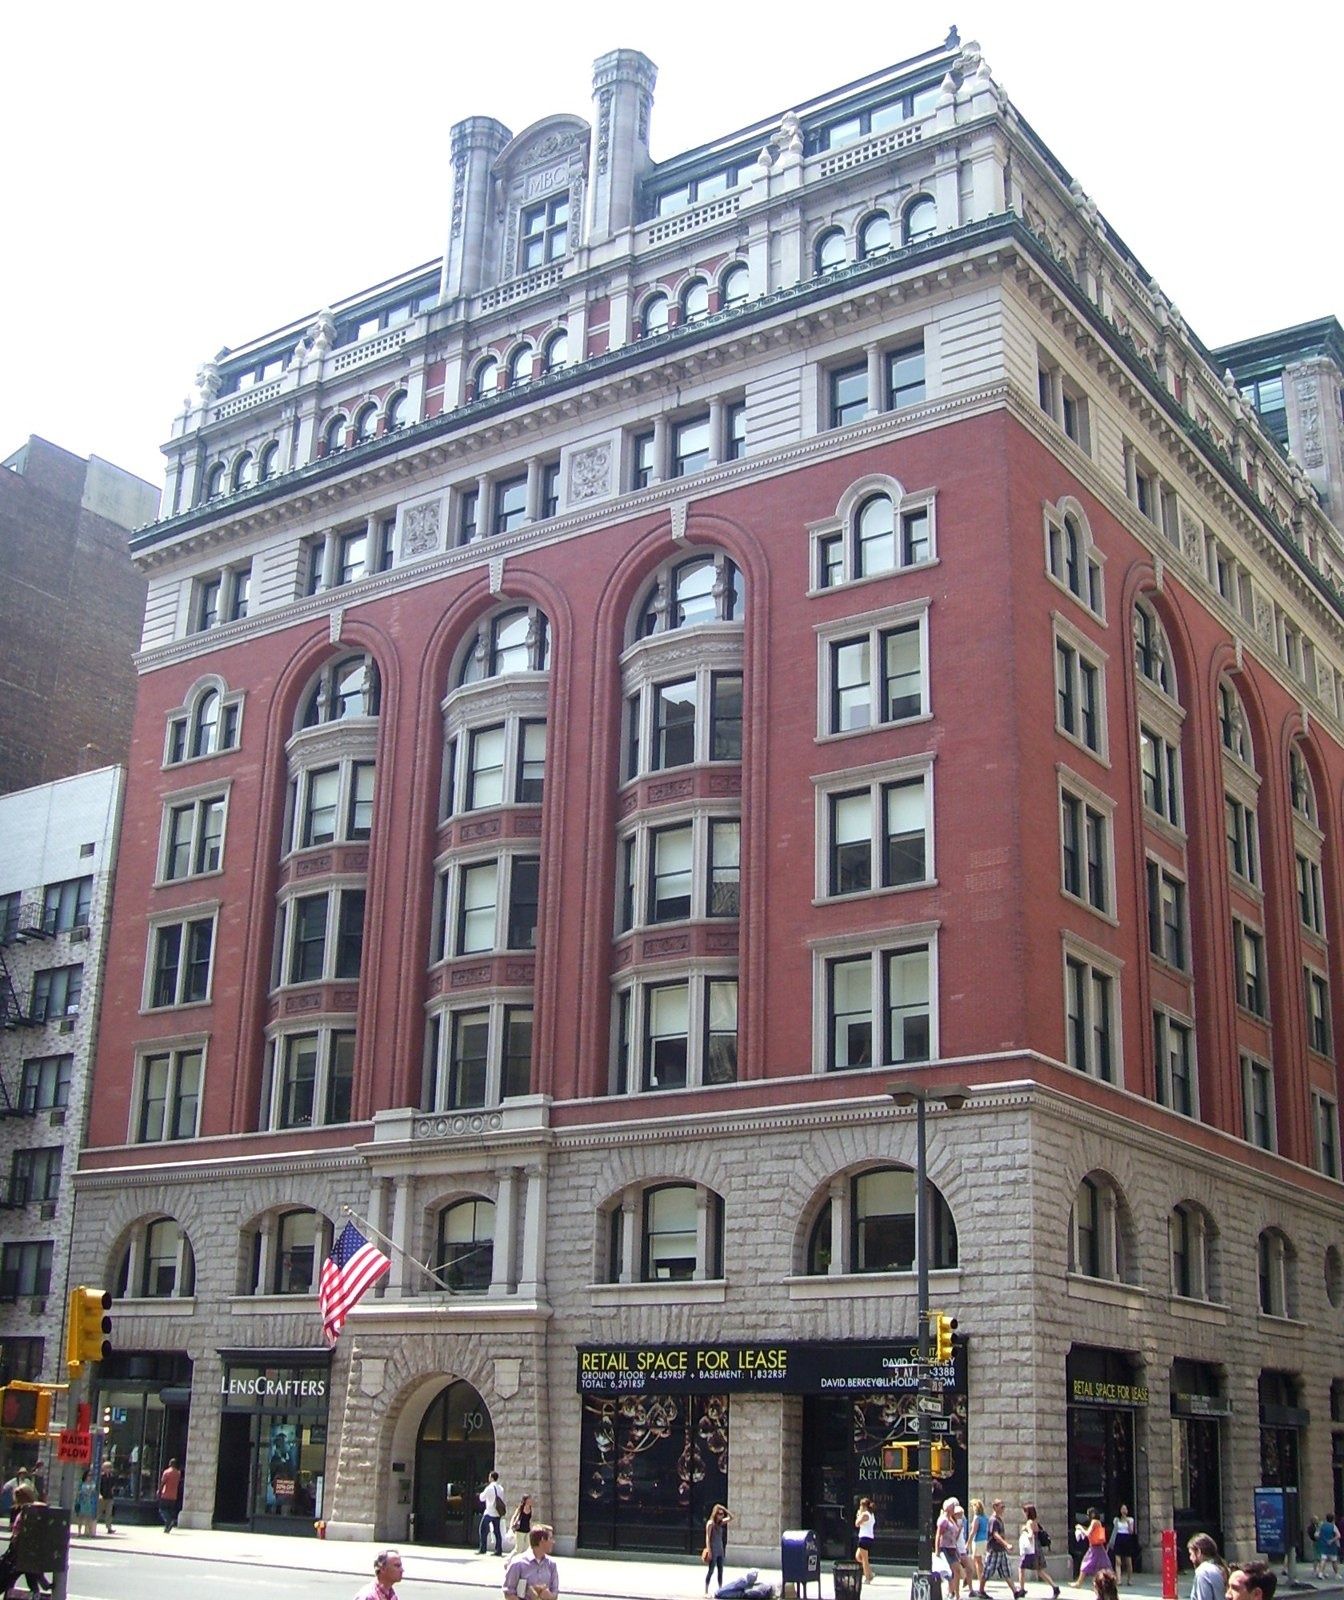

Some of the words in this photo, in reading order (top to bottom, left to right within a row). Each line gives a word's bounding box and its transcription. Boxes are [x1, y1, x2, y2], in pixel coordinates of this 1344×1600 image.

[529, 166, 566, 197] MBC
[582, 1352, 630, 1371] RETAIL
[637, 1351, 688, 1370] SPACE
[697, 1350, 730, 1370] FOR
[738, 1349, 787, 1369] LEASE
[882, 1358, 908, 1367] DAVID
[581, 1371, 616, 1380] GROUND
[619, 1371, 647, 1380] FLOOR:
[699, 1370, 745, 1380] BASEMENT:
[221, 1376, 326, 1396] LENSCRAFTERS
[581, 1379, 607, 1389] TOTAL:
[610, 1379, 646, 1389] 6,291RSF
[1073, 1380, 1094, 1396] RETAIL
[1095, 1382, 1116, 1398] SPACE
[1117, 1385, 1130, 1400] FOR
[1131, 1386, 1149, 1401] LEASE
[463, 1412, 484, 1434] 150
[61, 1435, 88, 1447] RAISE
[60, 1447, 88, 1459] PLOW
